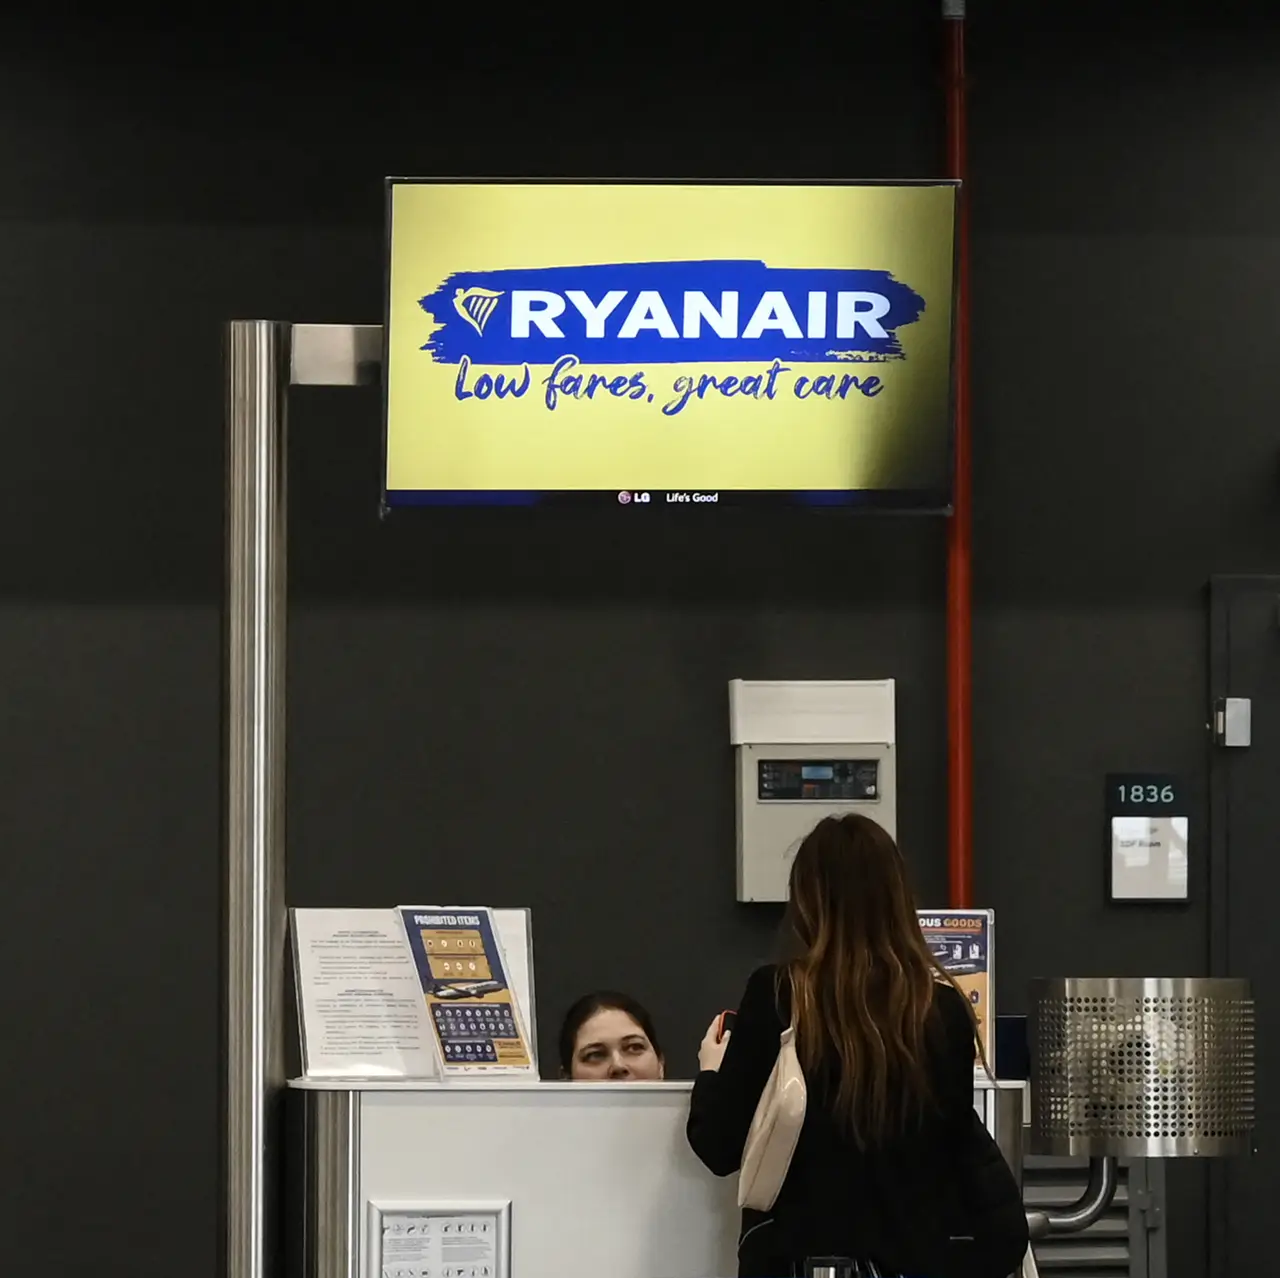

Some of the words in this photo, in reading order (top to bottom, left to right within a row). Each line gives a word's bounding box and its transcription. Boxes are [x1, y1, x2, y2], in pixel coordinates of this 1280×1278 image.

[510, 290, 891, 339] RYANAIR
[454, 354, 531, 401] Low
[541, 354, 655, 411] fares,
[661, 358, 791, 416] great
[792, 375, 885, 401] care
[634, 492, 651, 503] LG
[666, 492, 691, 503] Life's
[692, 492, 719, 503] Good
[1118, 784, 1174, 803] 1836
[943, 918, 982, 928] GOODS
